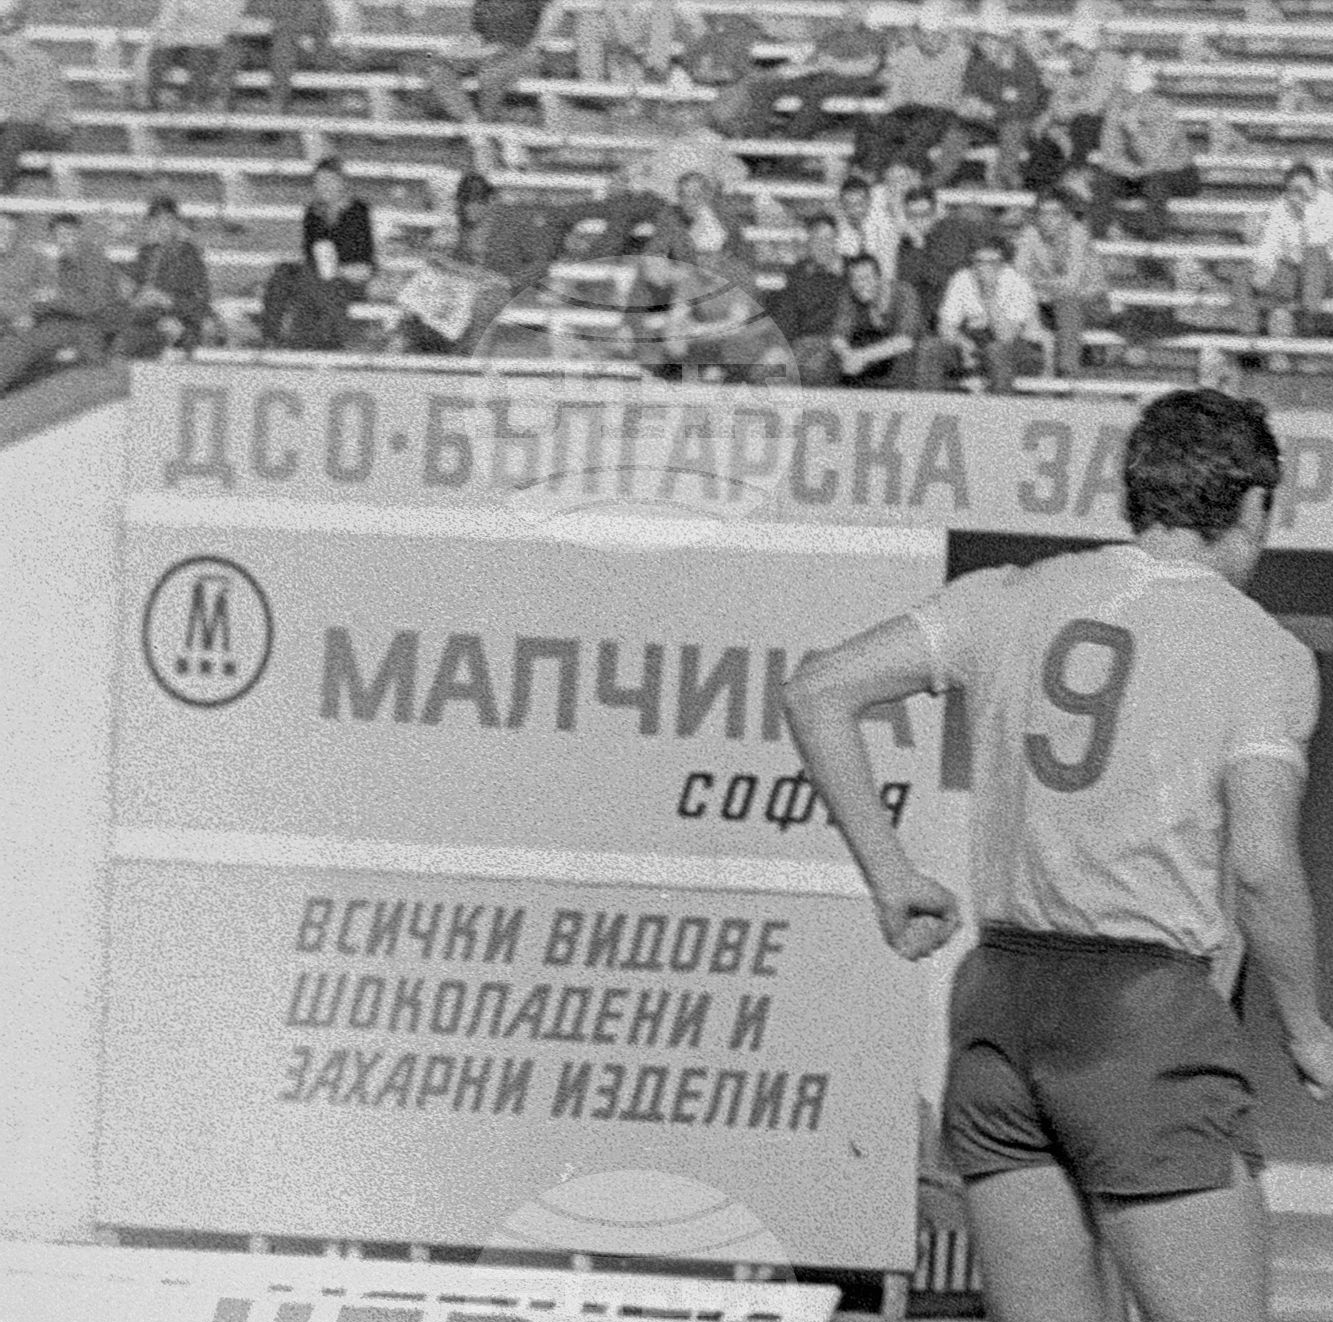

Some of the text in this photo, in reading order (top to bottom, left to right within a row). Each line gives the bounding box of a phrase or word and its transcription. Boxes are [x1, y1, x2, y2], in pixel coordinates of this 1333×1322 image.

[1022, 617, 1136, 794] 9
[676, 772, 911, 831] СОФЯ
[295, 896, 790, 978] ВСИЧКИ ВИДОВЕ
[285, 973, 771, 1052] ШОКОЛАДЕНИ И
[277, 1046, 828, 1131] ЗАХАРНИ ИЗДЕЛИЯ
